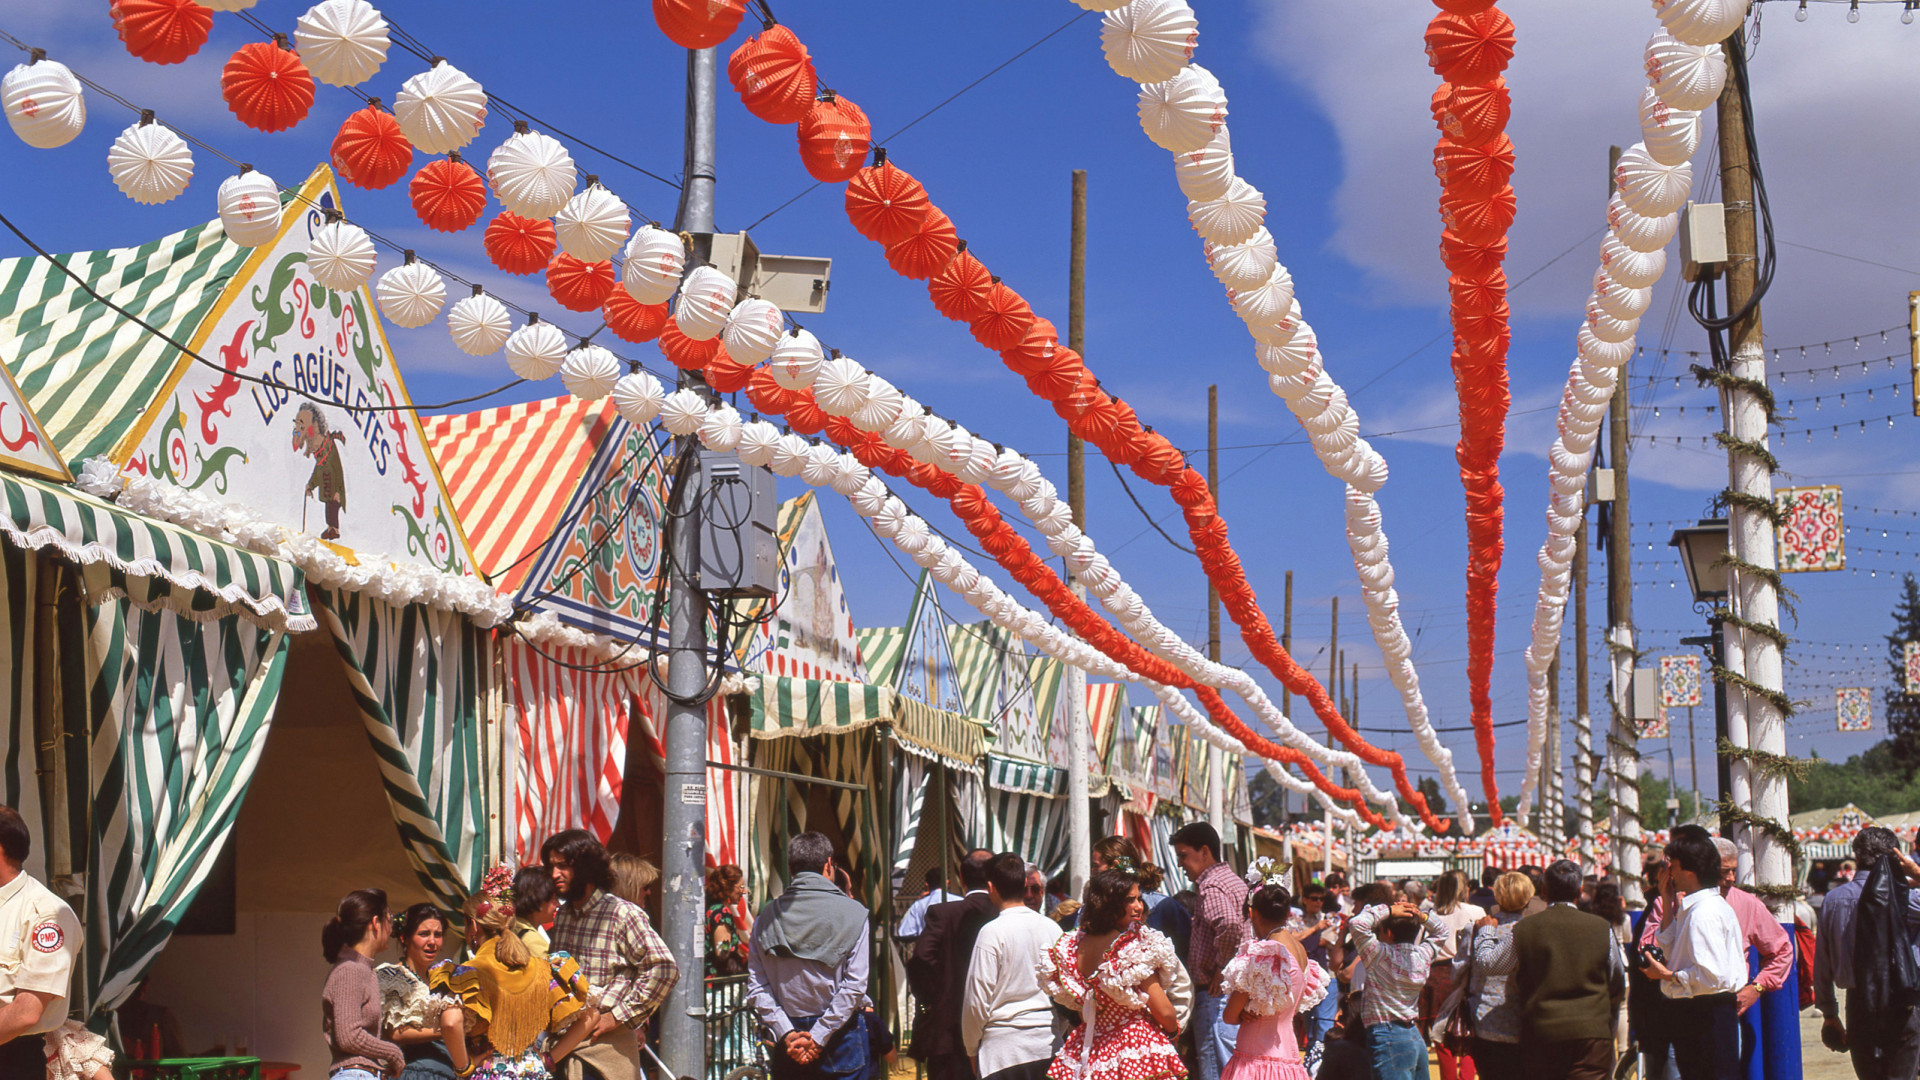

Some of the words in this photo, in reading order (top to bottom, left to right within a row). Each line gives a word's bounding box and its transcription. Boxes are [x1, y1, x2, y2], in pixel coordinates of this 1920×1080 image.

[251, 360, 289, 426] LOS
[293, 345, 391, 476] AGÜELETES
[34, 923, 60, 934] SERVICIO
[39, 931, 56, 943] PMP
